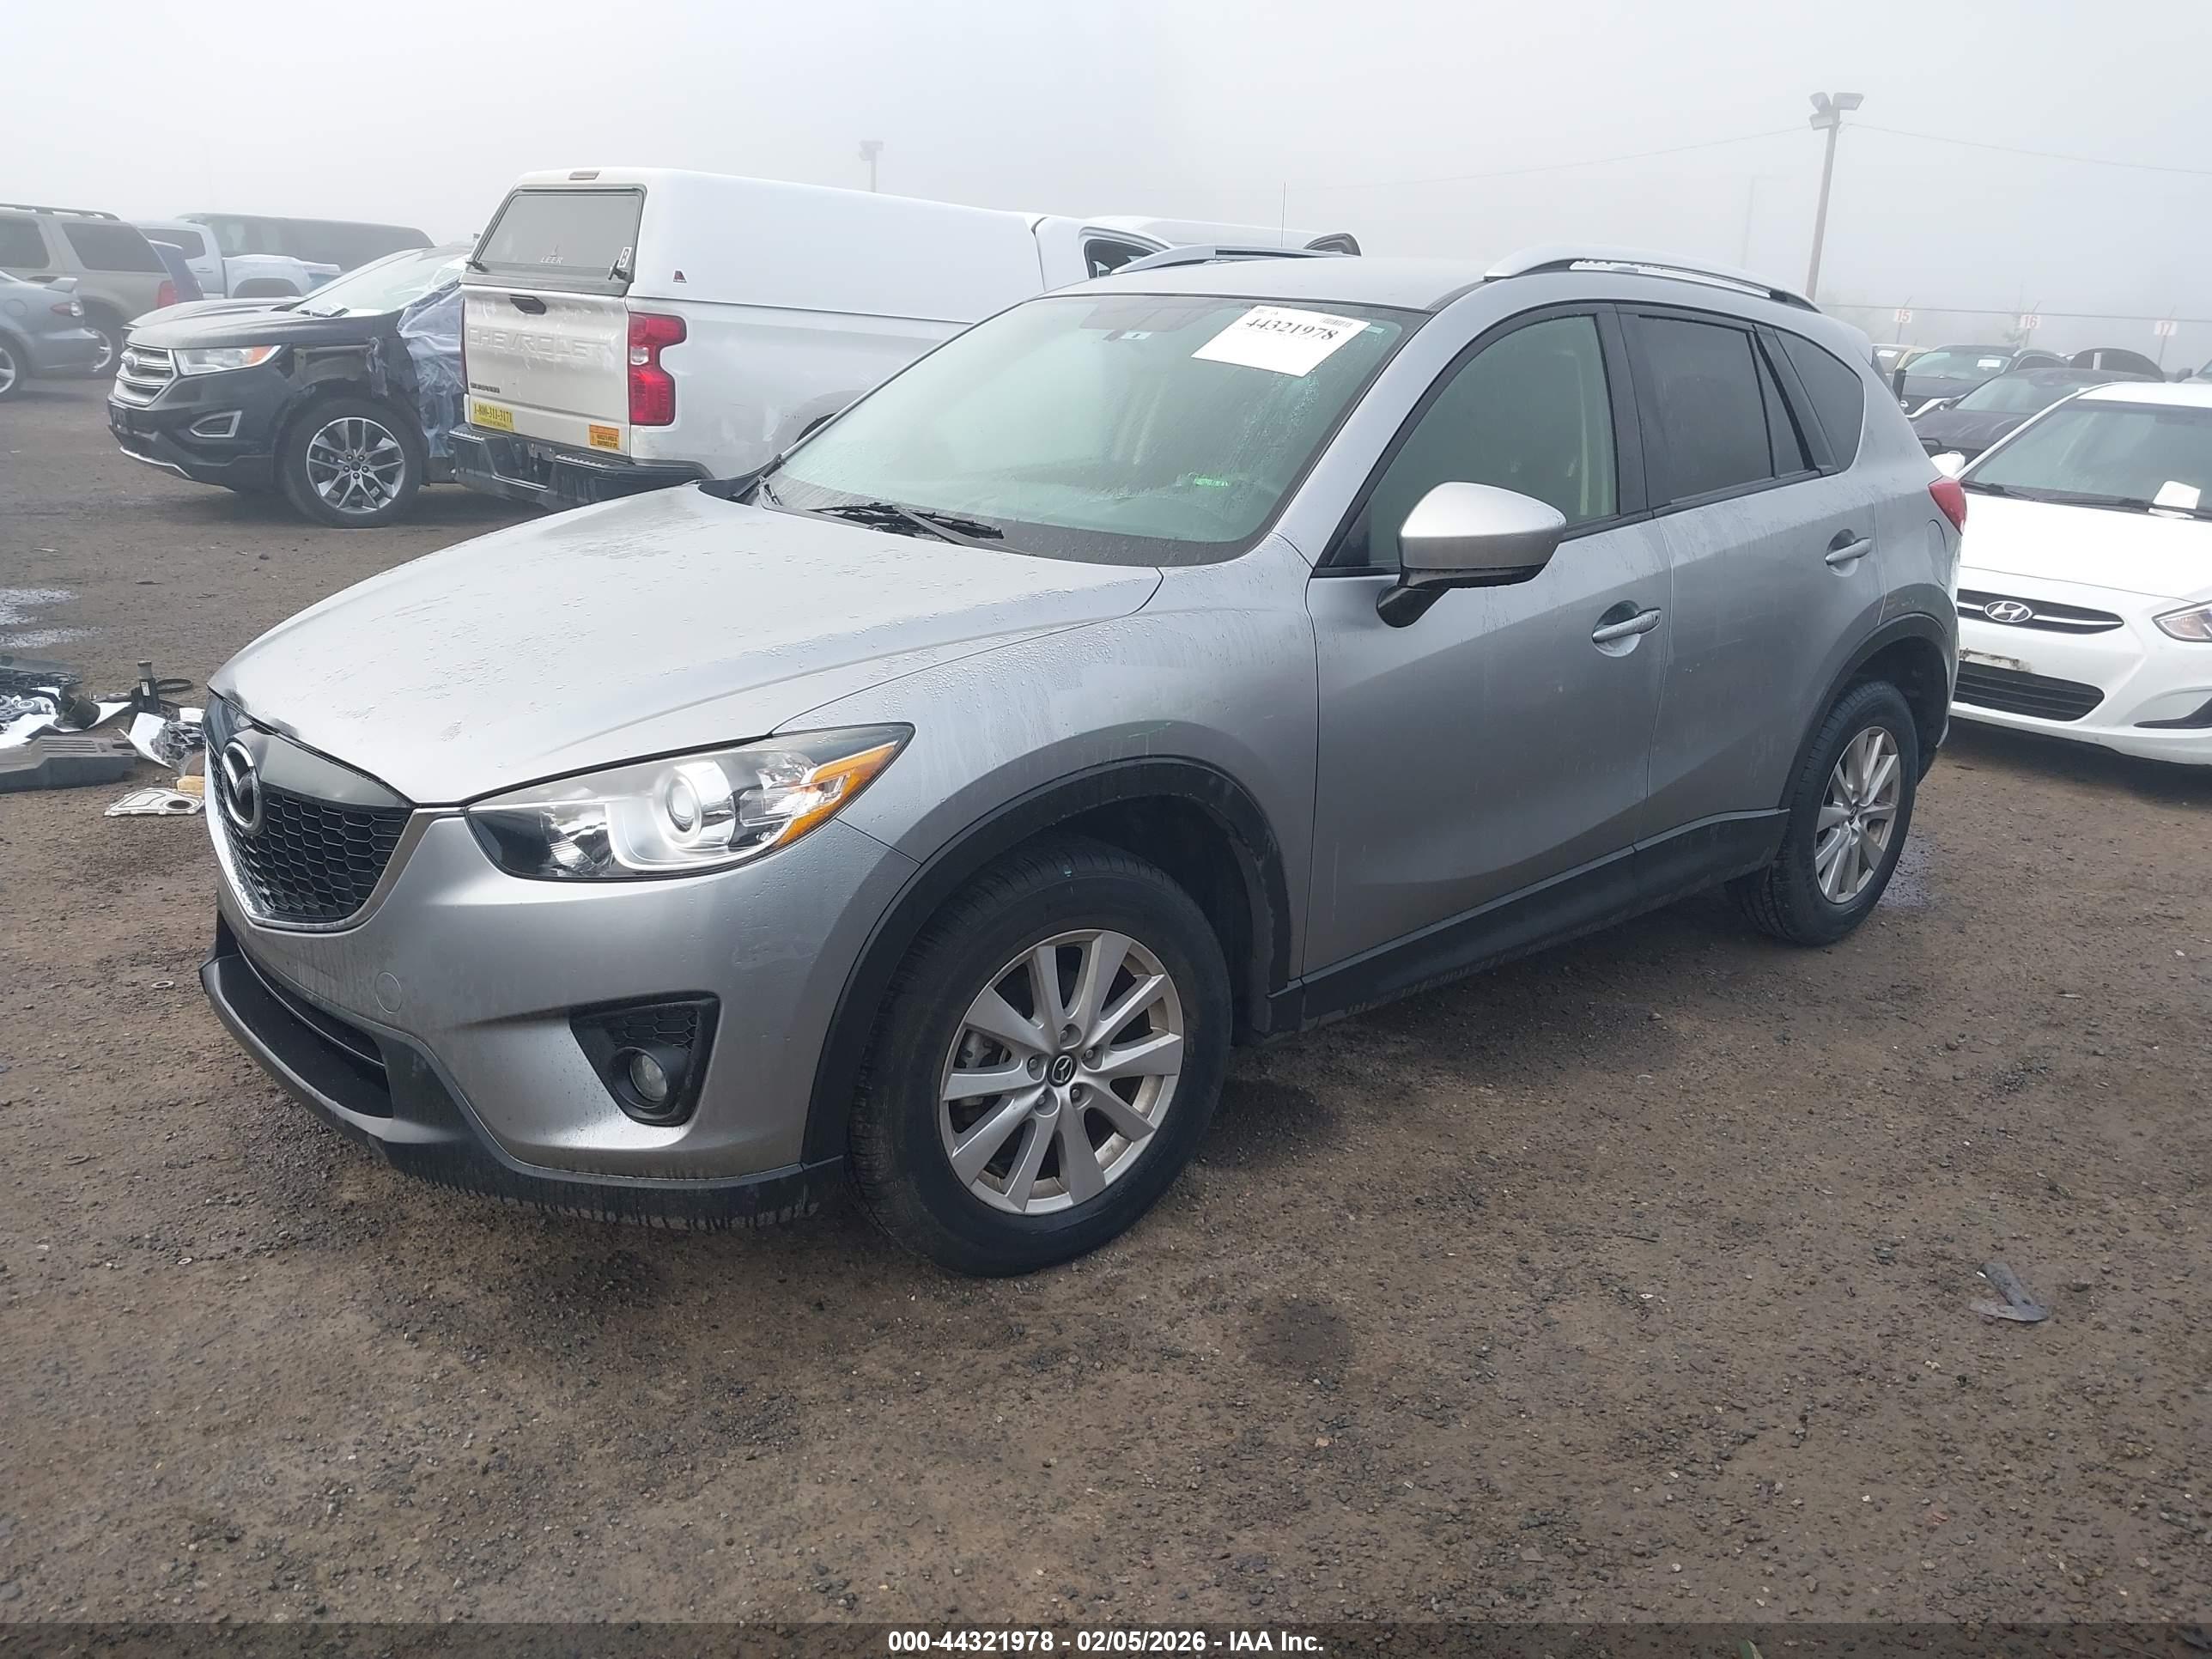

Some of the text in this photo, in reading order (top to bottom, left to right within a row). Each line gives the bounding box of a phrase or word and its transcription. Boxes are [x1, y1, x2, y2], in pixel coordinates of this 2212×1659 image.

[1896, 309, 1911, 323] 15
[2023, 315, 2038, 329] 16
[1245, 318, 1339, 341] 44321978
[2159, 321, 2172, 337] 17
[468, 327, 609, 362] CHEVROLET
